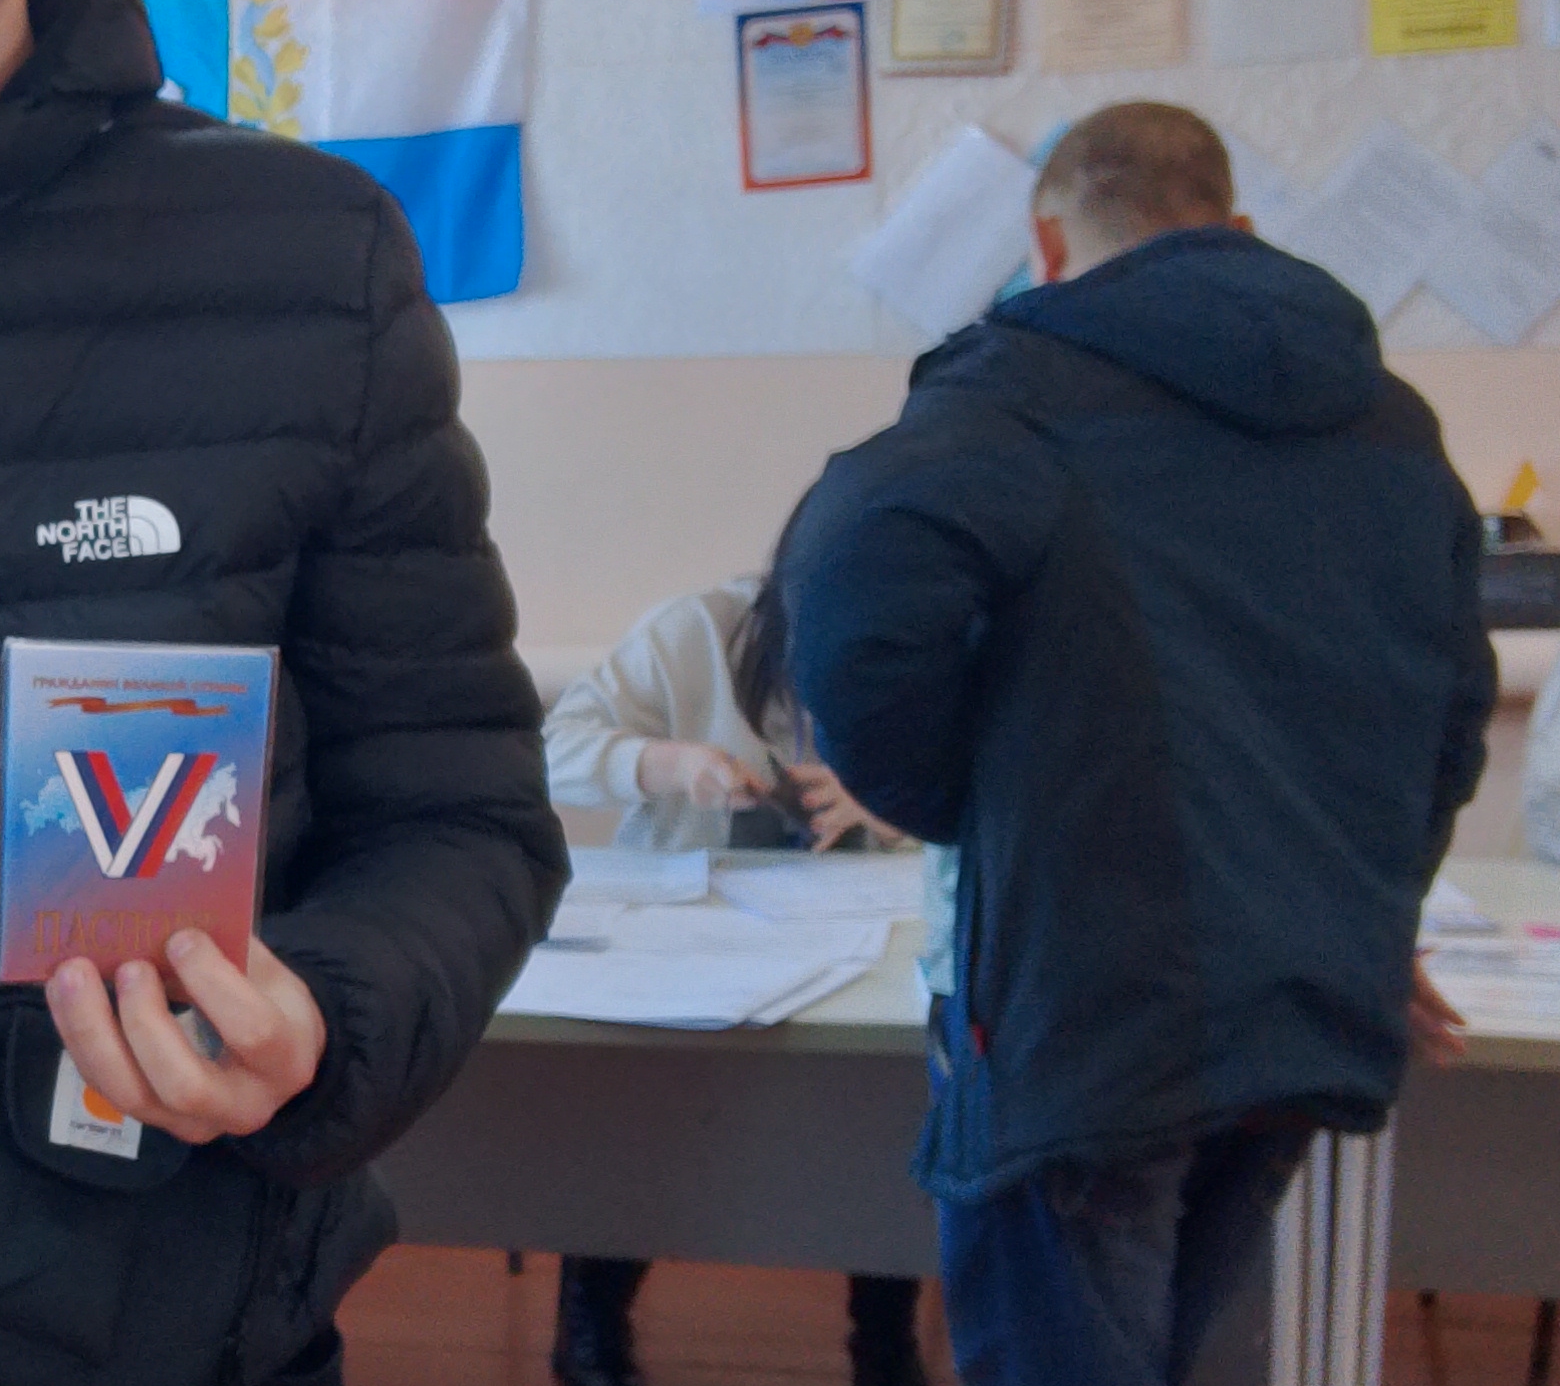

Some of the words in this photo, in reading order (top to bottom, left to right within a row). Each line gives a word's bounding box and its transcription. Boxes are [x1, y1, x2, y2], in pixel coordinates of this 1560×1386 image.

[74, 495, 127, 522] THE
[36, 514, 128, 547] NORTH
[62, 537, 130, 564] FACE
